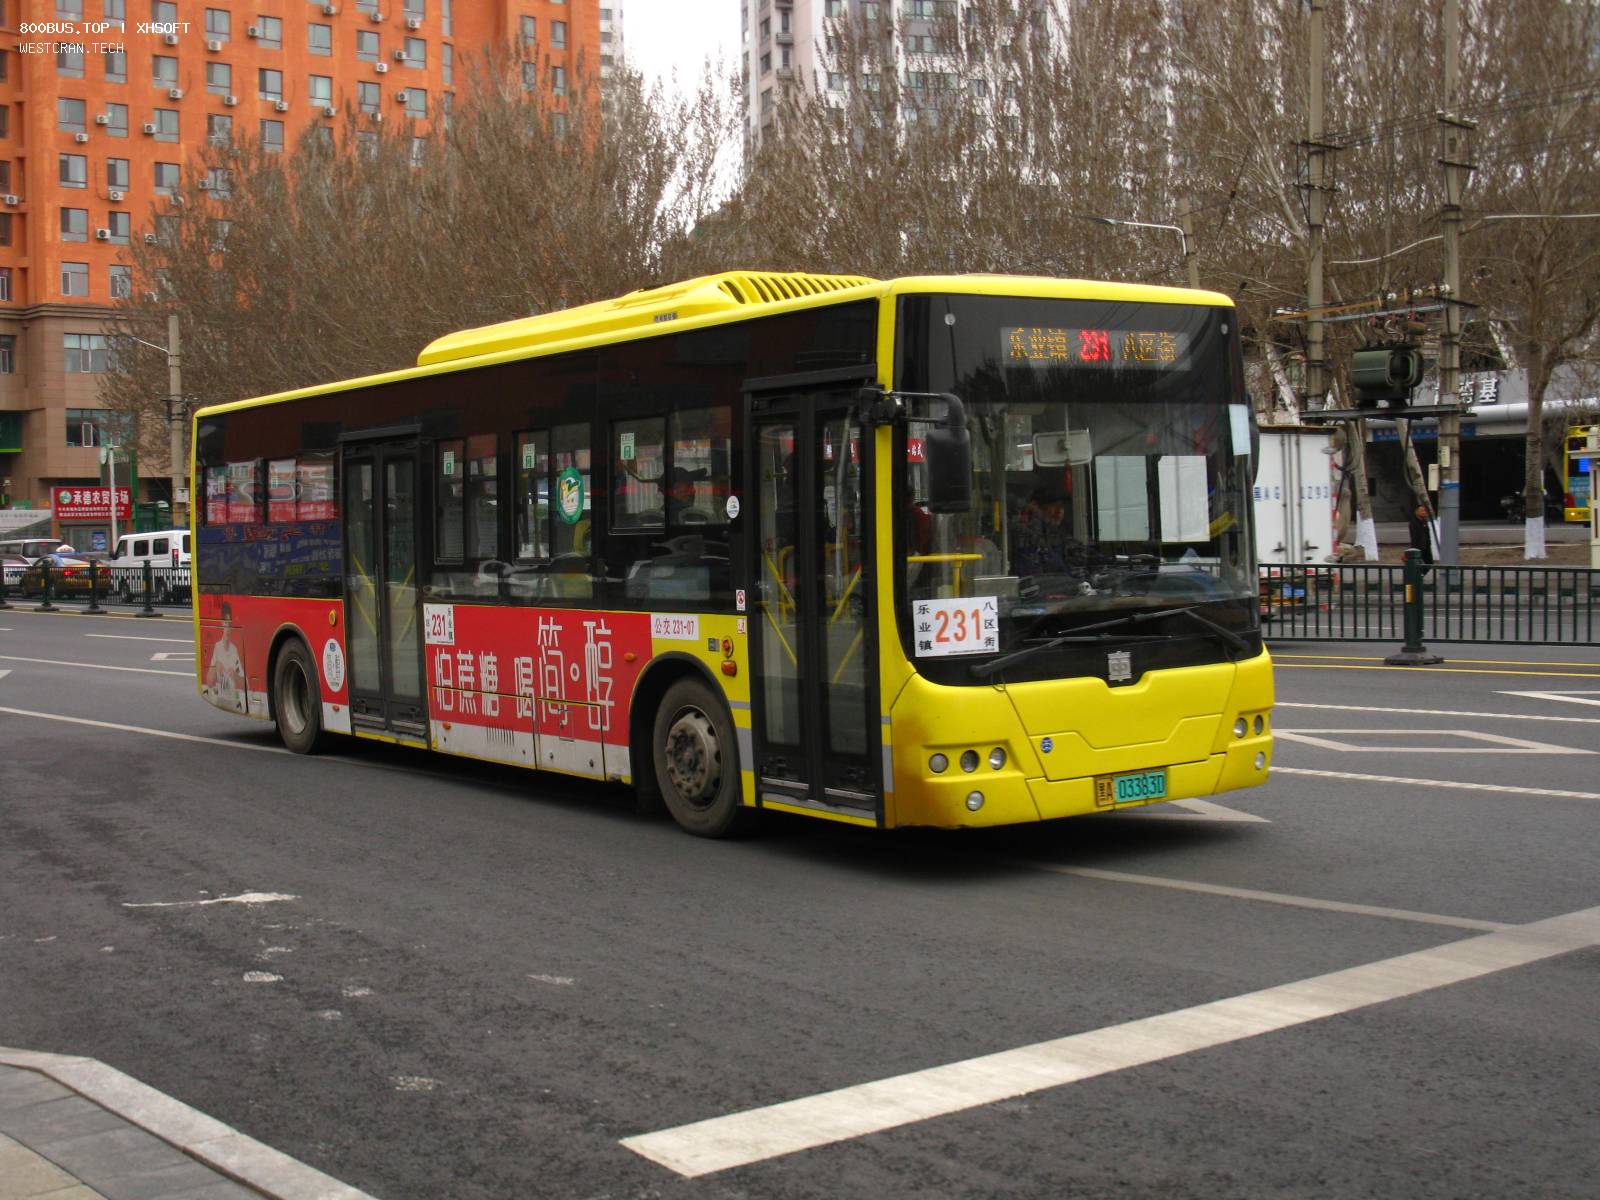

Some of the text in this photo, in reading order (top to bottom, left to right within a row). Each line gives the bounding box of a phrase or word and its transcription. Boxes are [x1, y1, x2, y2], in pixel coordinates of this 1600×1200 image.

[1078, 328, 1111, 361] 231
[431, 613, 446, 637] 231
[917, 604, 933, 651] 乐业镇
[934, 608, 981, 643] 231
[983, 601, 996, 648] 八区街
